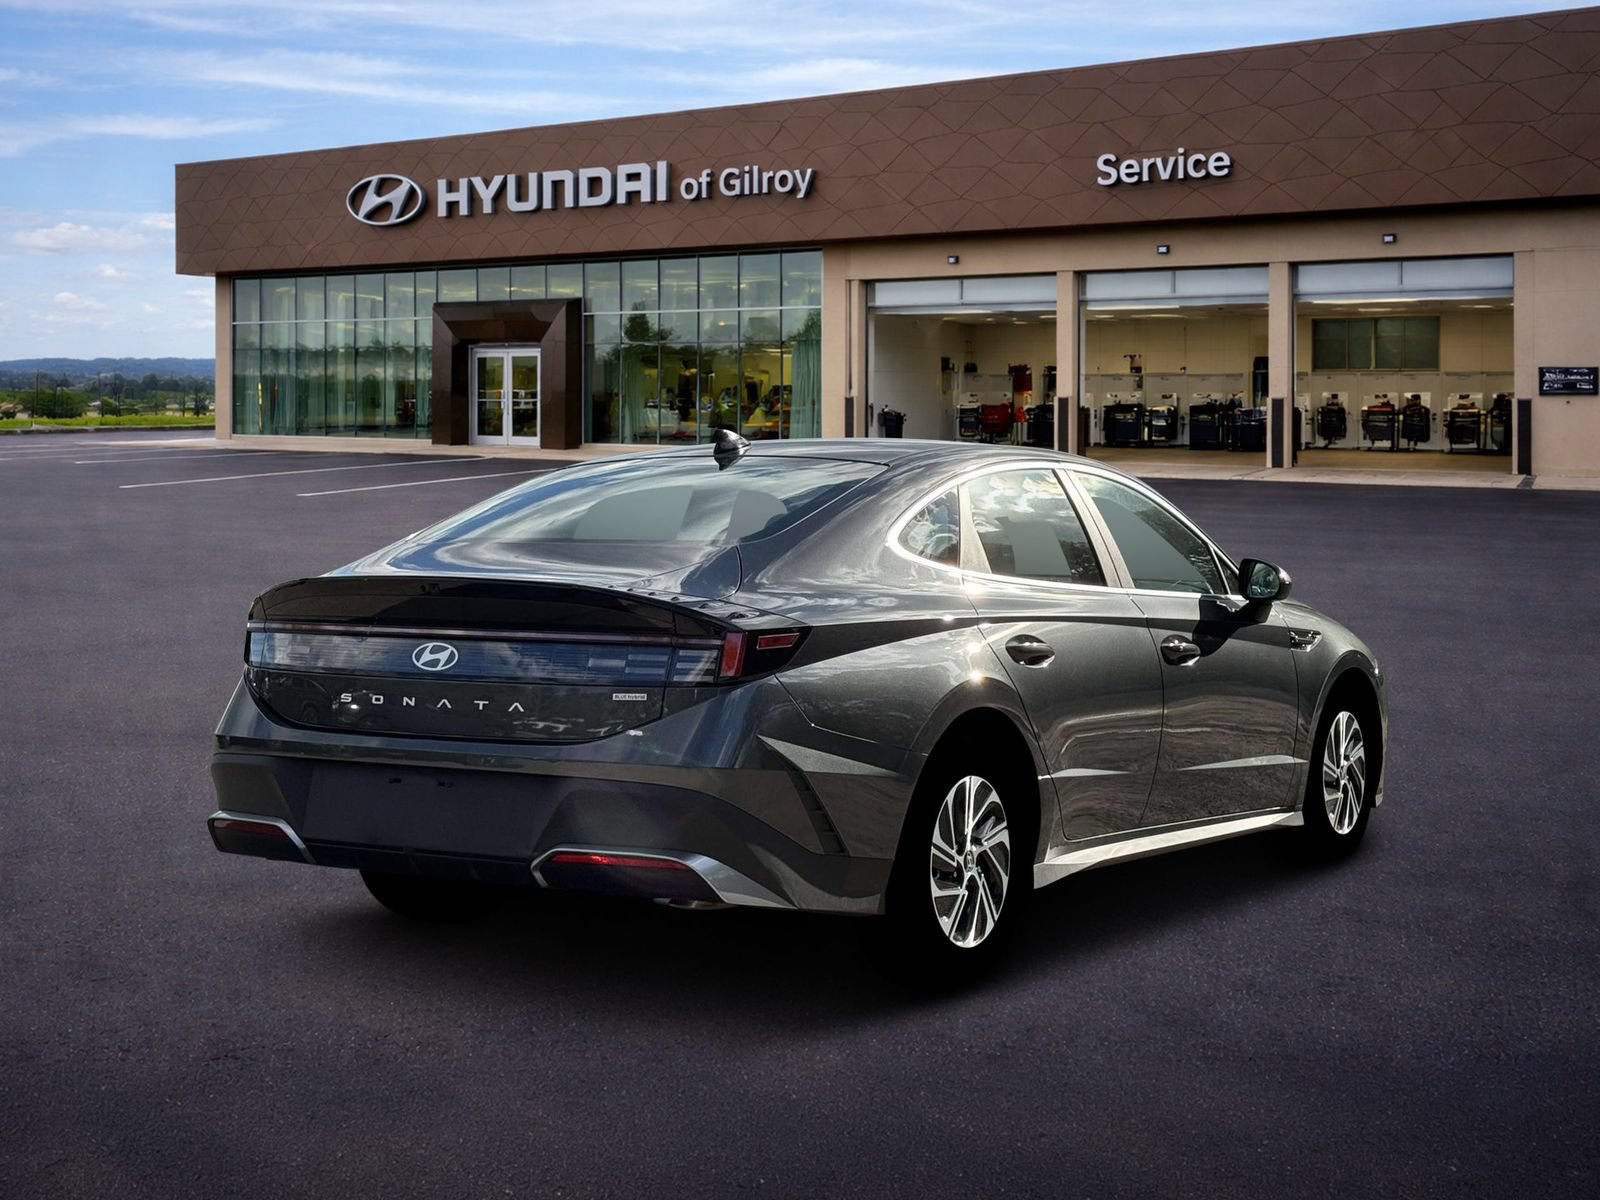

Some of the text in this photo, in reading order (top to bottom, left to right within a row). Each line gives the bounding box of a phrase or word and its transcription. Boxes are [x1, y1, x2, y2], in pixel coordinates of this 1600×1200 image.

[1096, 147, 1232, 186] Service
[437, 160, 813, 217] HYUNDAI of Gilroy
[340, 693, 525, 712] SONATA
